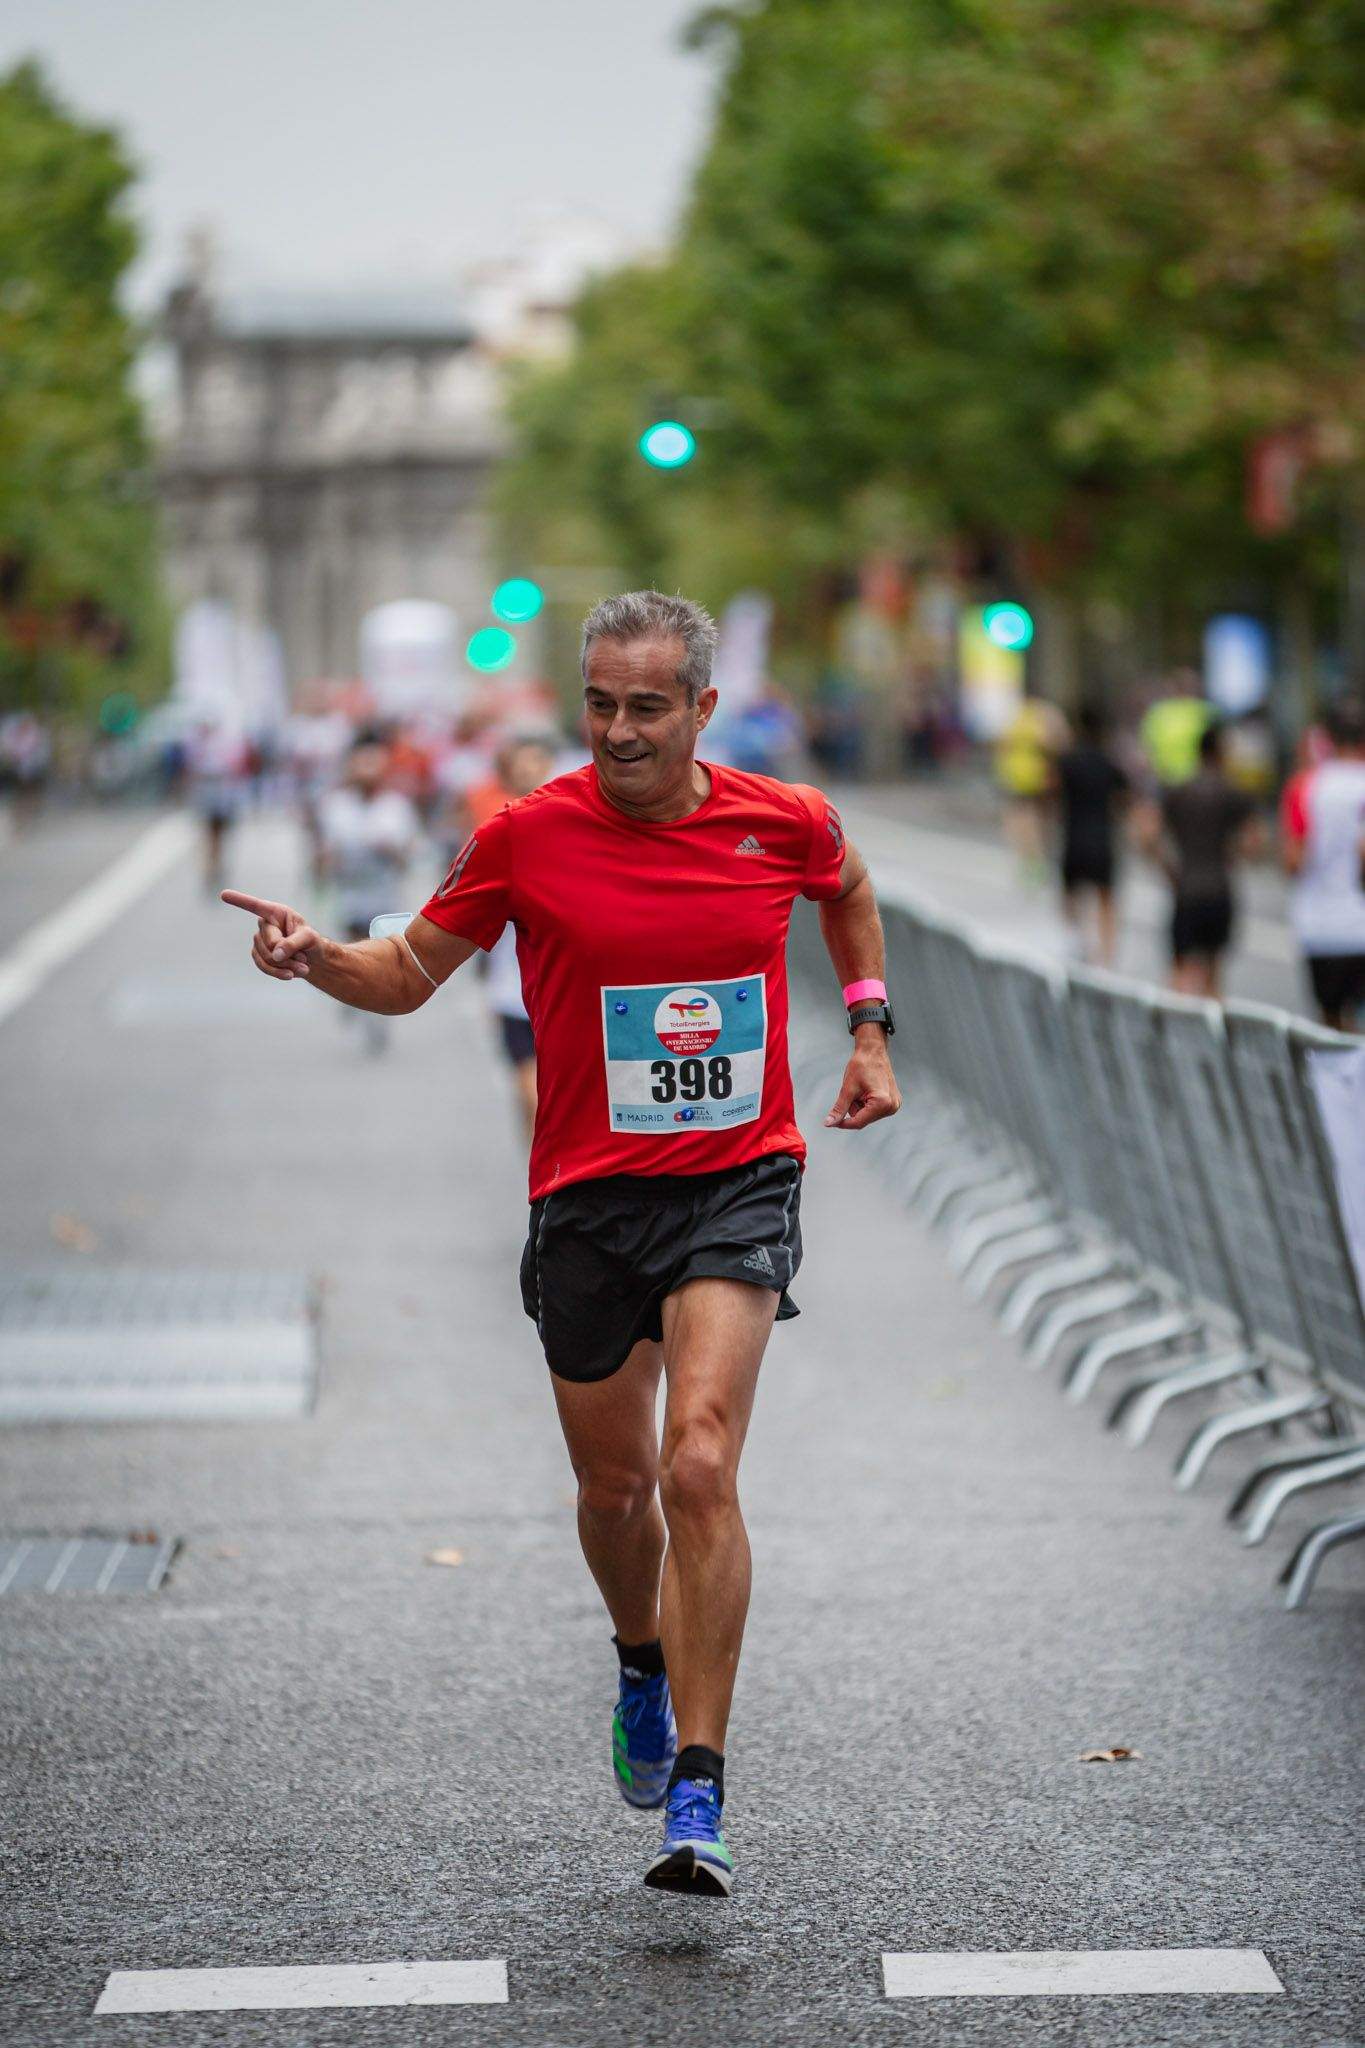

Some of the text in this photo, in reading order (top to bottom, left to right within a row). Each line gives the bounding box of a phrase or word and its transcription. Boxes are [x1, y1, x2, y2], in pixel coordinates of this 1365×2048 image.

[651, 1056, 732, 1103] 398
[627, 1114, 664, 1122] MADRID
[743, 1259, 776, 1277] adidas
